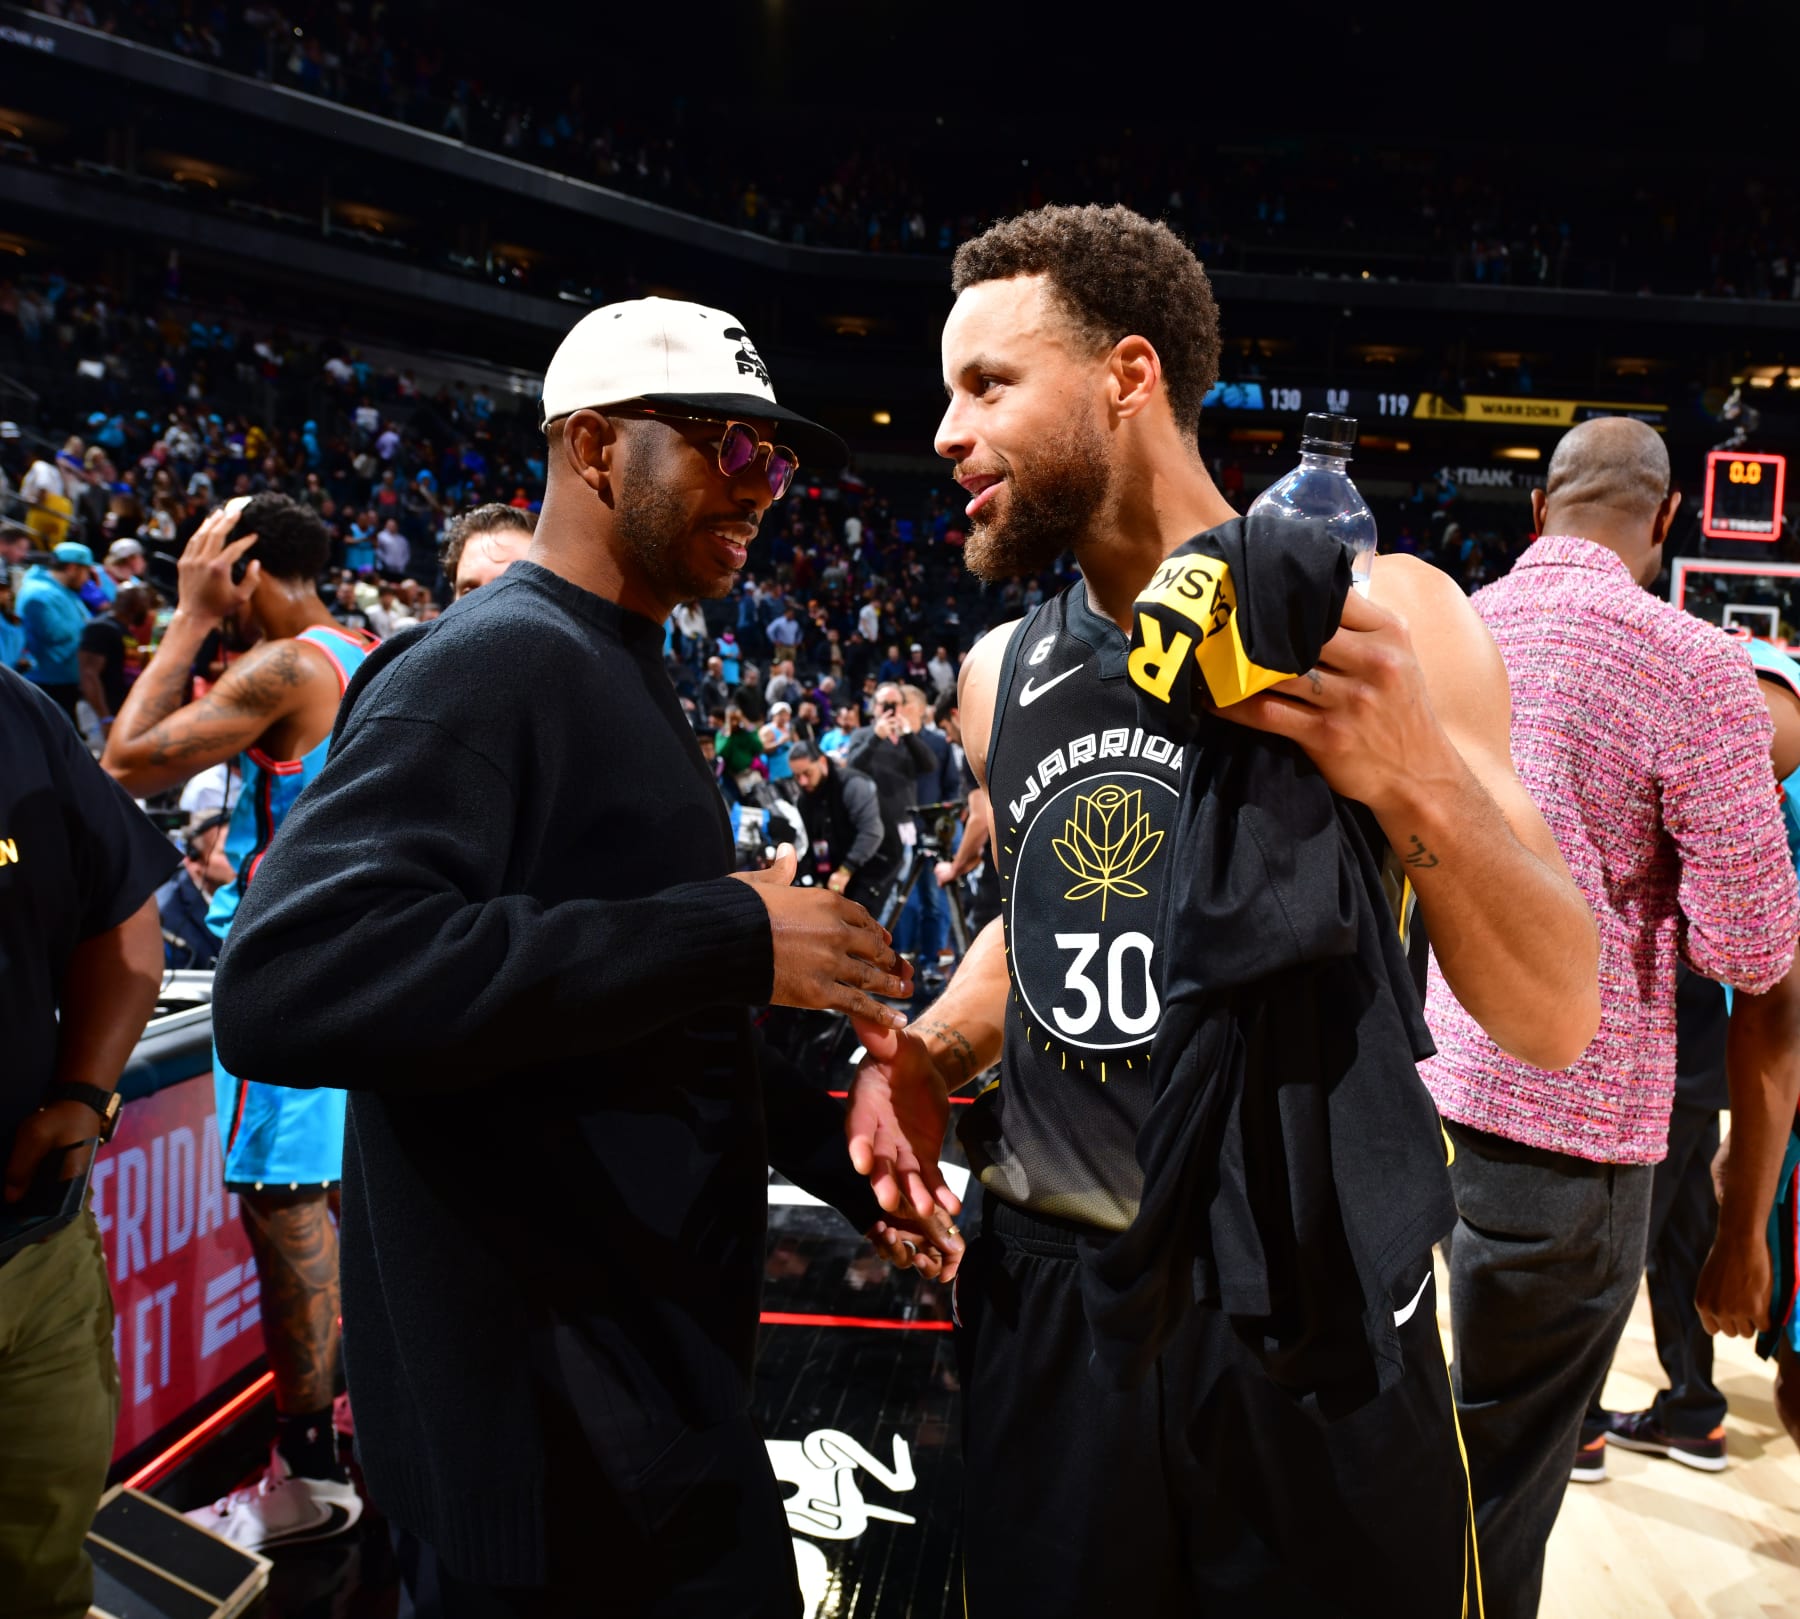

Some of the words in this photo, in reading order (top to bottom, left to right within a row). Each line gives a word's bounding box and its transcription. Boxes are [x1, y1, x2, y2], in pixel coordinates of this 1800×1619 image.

[1270, 388, 1302, 411] 130
[1378, 394, 1410, 416] 119
[1481, 403, 1561, 419] WARRIORS
[1729, 461, 1762, 485] 0.0
[1028, 634, 1056, 666] 6
[1127, 611, 1193, 704] R
[1052, 931, 1161, 1035] 30
[91, 1112, 241, 1284] FRIDA
